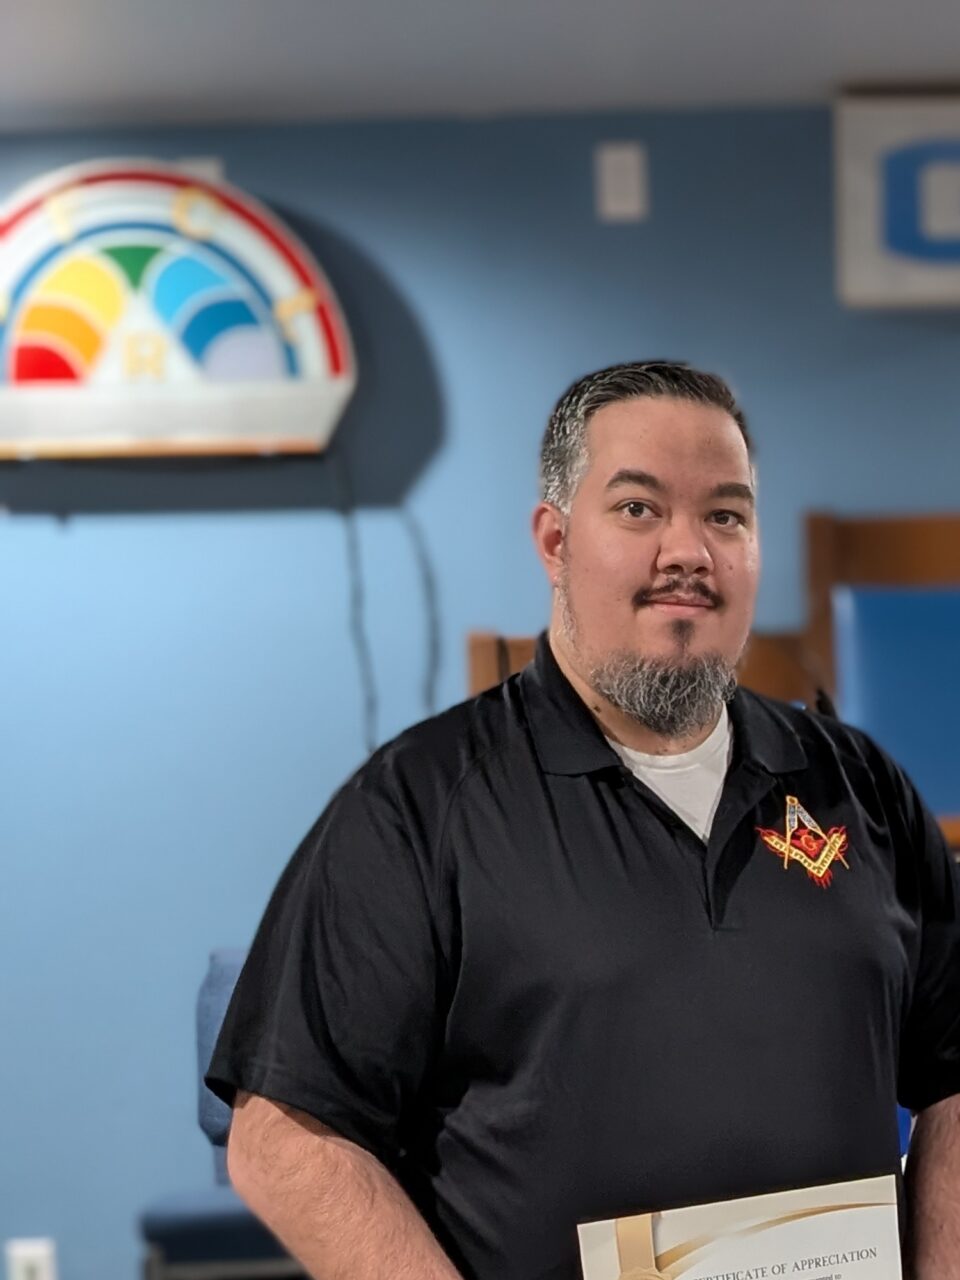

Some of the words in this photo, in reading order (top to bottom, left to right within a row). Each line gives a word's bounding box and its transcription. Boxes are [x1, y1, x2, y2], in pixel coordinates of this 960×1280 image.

[800, 834, 817, 851] G
[771, 1263, 788, 1276] OF
[792, 1247, 877, 1272] APPRECIATION
[835, 1273, 842, 1280] to
